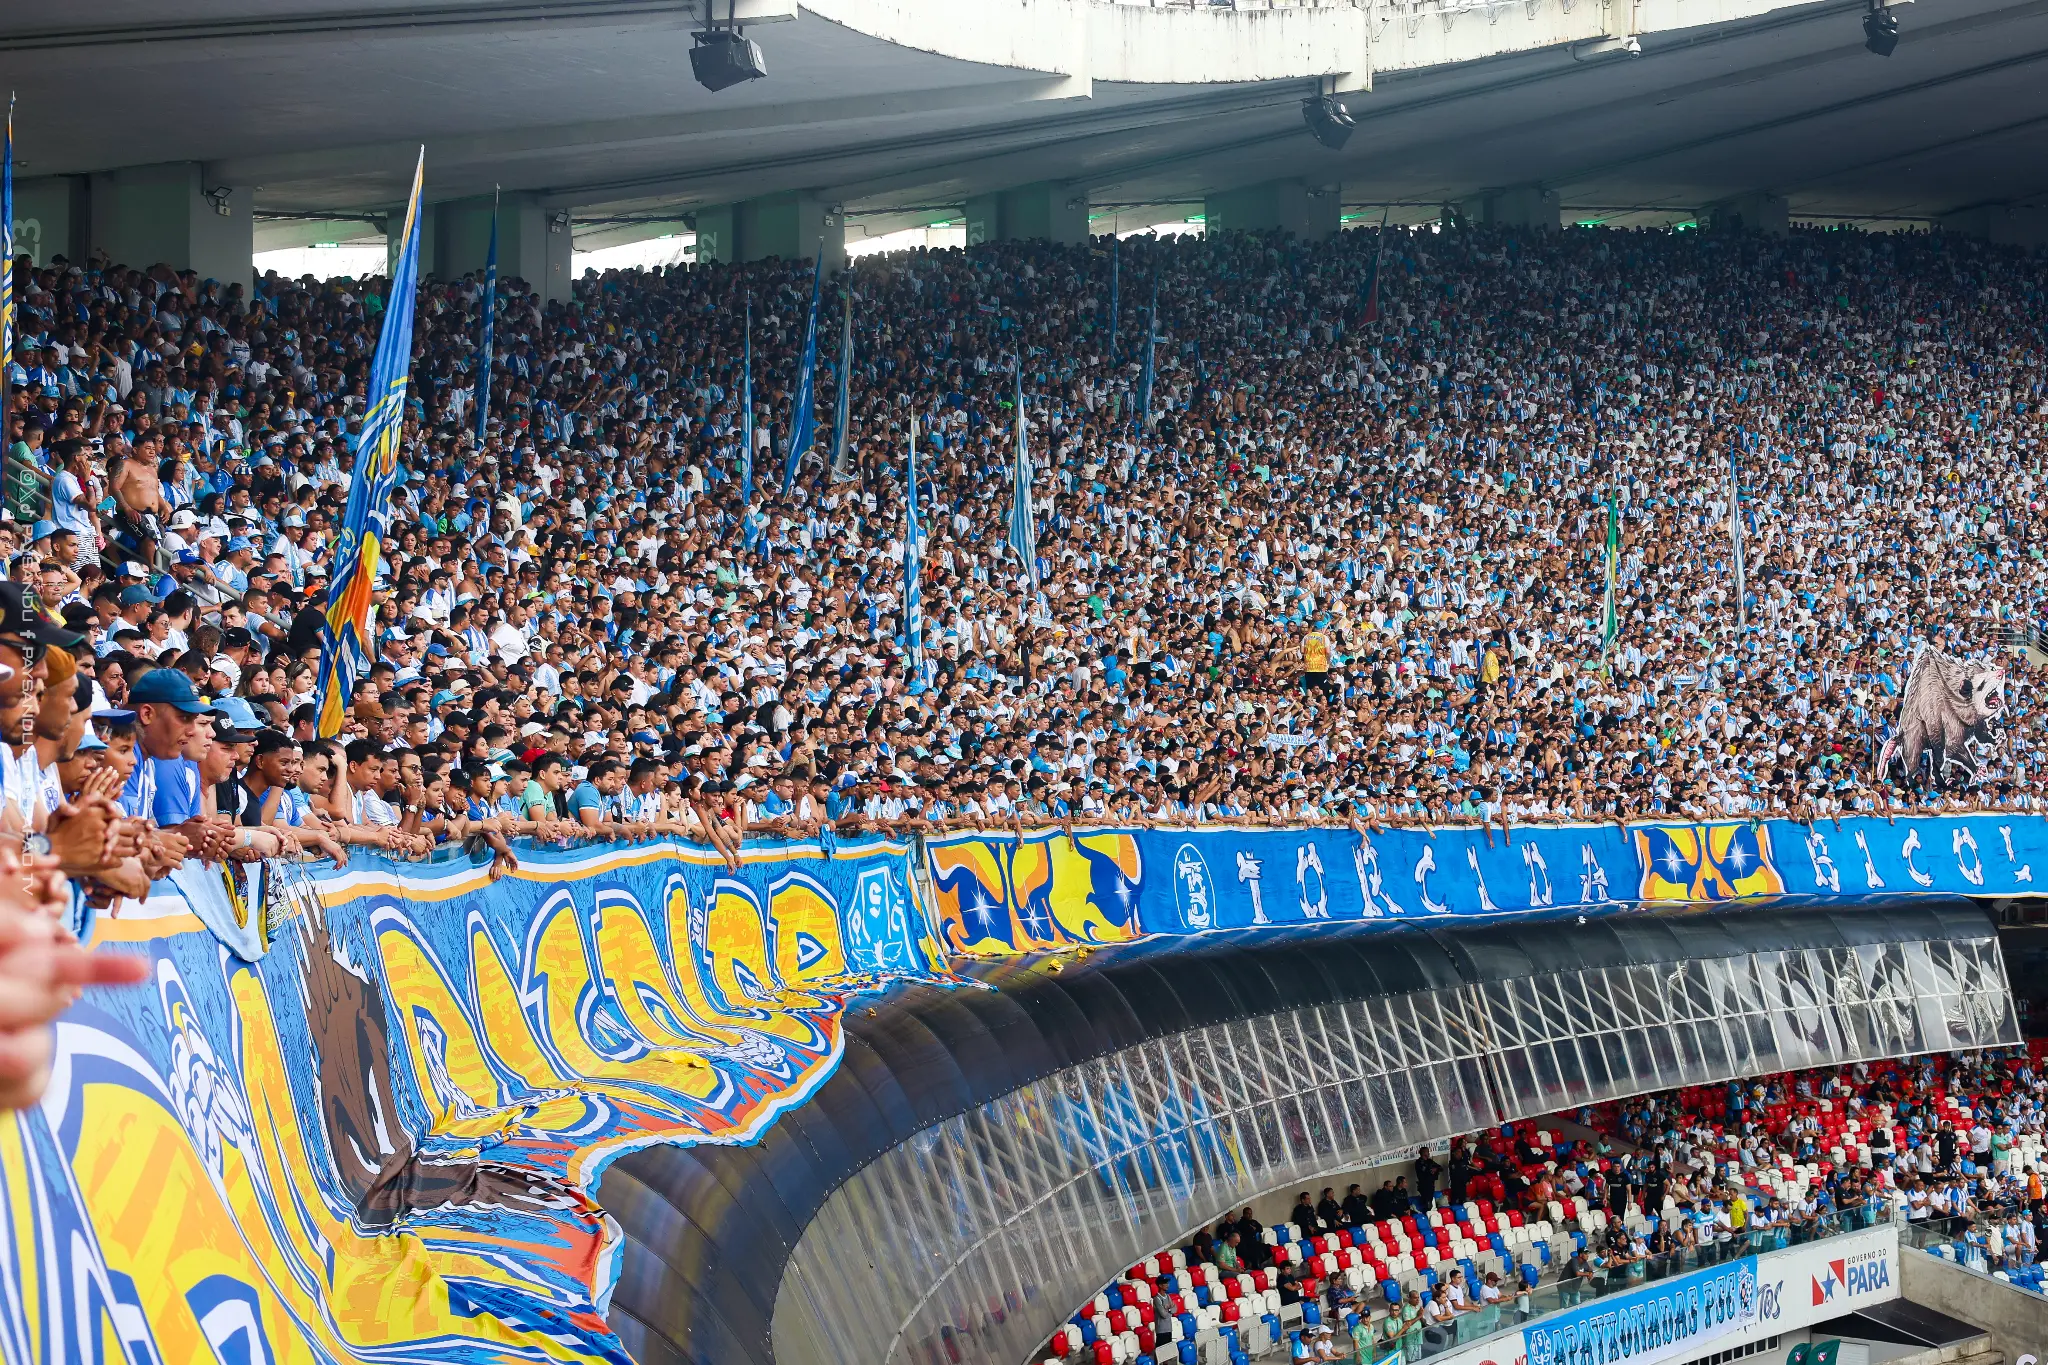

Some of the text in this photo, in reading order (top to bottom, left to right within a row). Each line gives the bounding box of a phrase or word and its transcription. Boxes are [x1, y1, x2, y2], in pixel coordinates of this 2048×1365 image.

[1236, 841, 1610, 925] TORCIDA
[1847, 1248, 1887, 1265] GOVERNO DO
[1552, 1271, 1736, 1365] APAYXONADAS PSC
